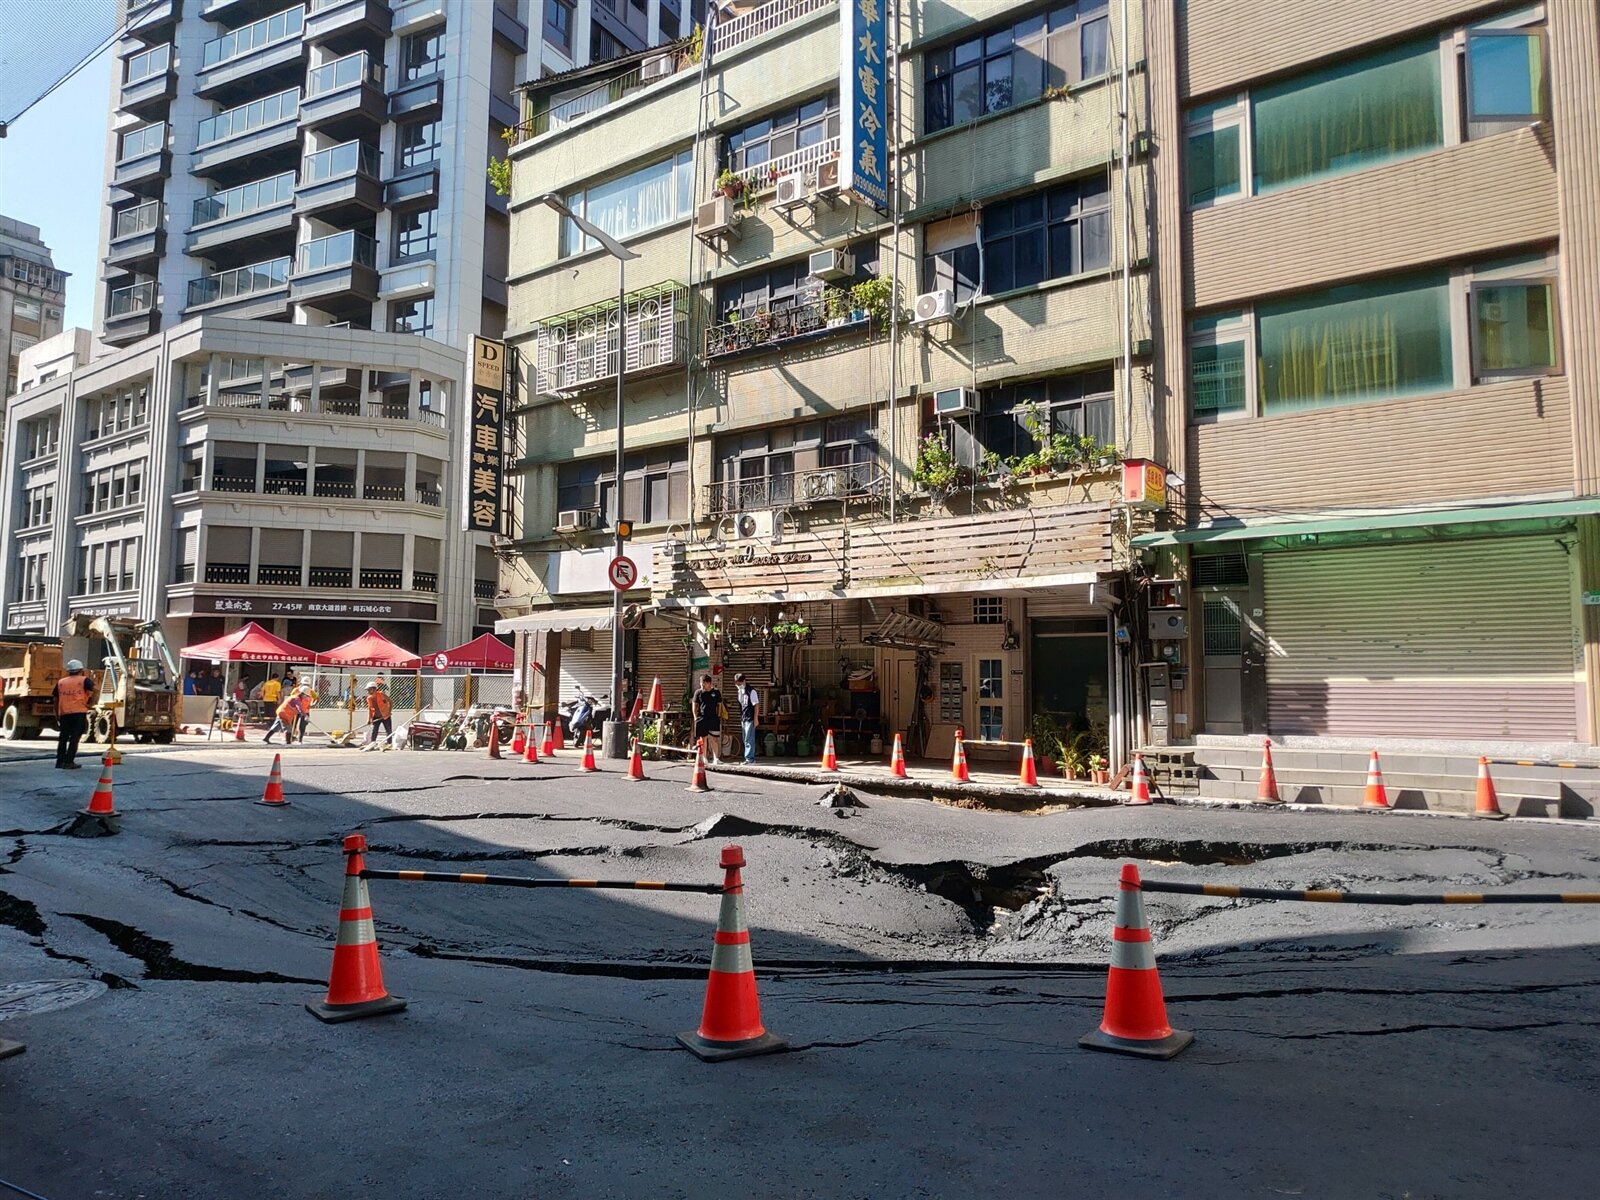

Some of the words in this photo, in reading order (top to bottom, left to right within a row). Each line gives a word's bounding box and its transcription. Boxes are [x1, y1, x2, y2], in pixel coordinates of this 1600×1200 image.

[477, 361, 500, 372] SPEED
[481, 344, 498, 361] D
[475, 392, 499, 451] 汽車
[473, 467, 497, 527] 美容
